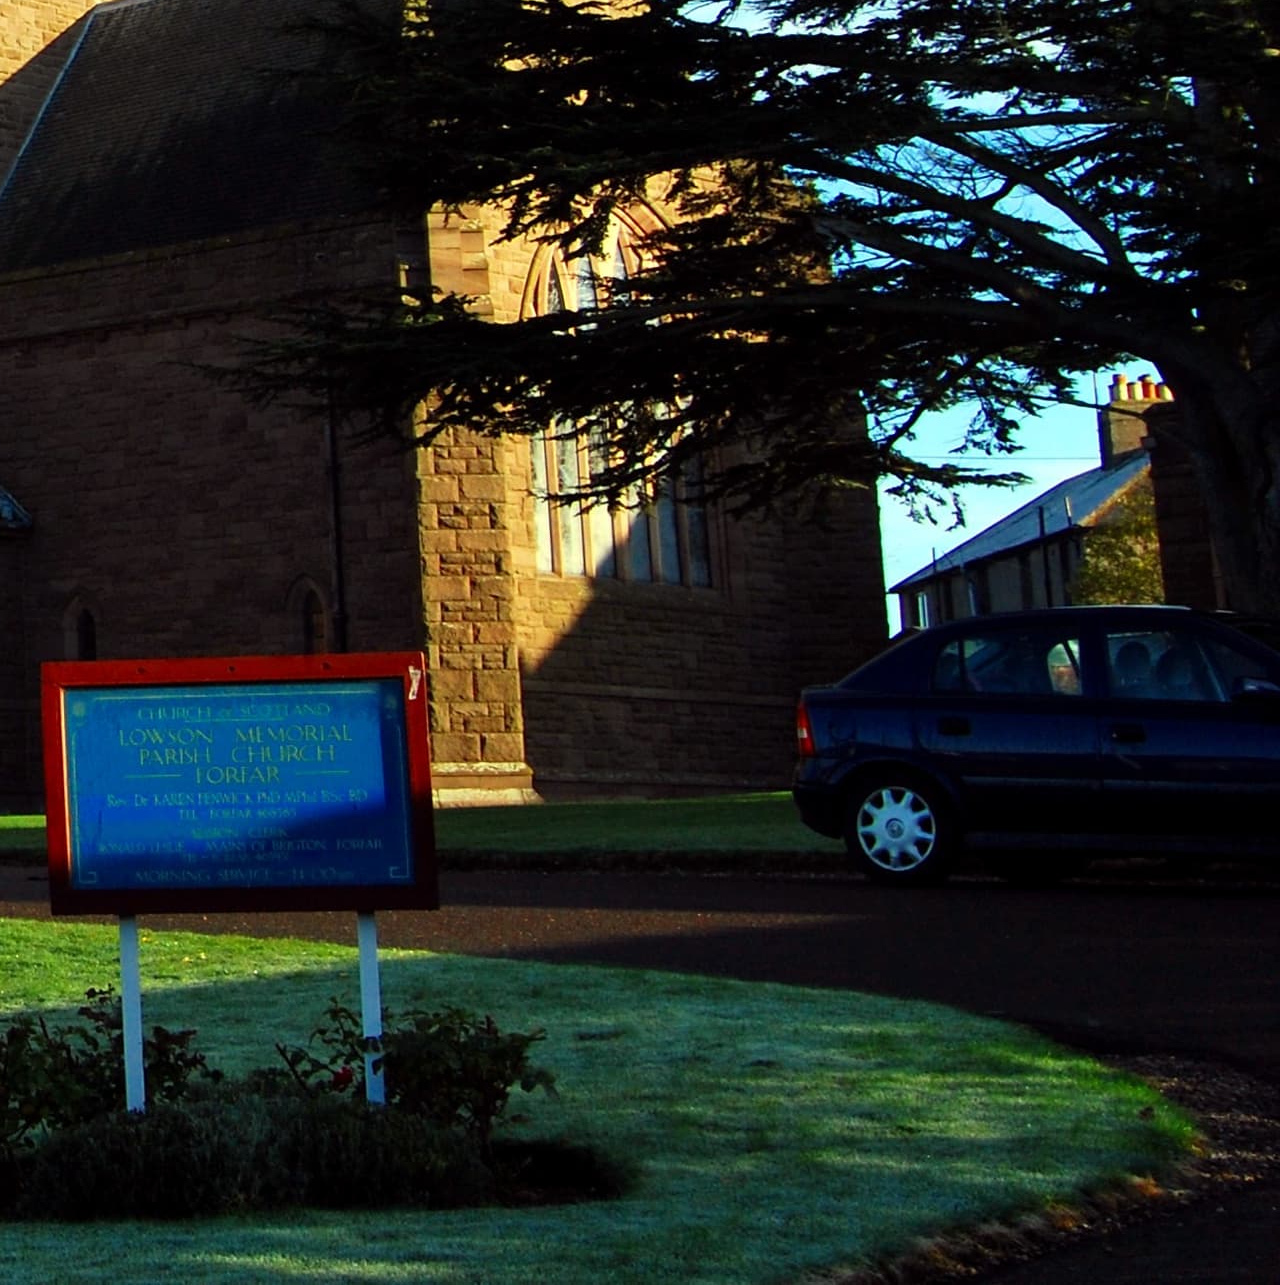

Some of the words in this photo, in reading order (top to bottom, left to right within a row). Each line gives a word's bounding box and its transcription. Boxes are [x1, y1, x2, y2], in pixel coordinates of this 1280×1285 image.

[137, 705, 211, 721] CHURCH
[240, 702, 331, 717] SCOTLAND
[119, 728, 213, 747] LOWSON
[235, 724, 353, 744] MEMORIAL
[139, 747, 211, 767] PARISH
[231, 744, 335, 763] CHURCH
[196, 765, 281, 785] FORFAR
